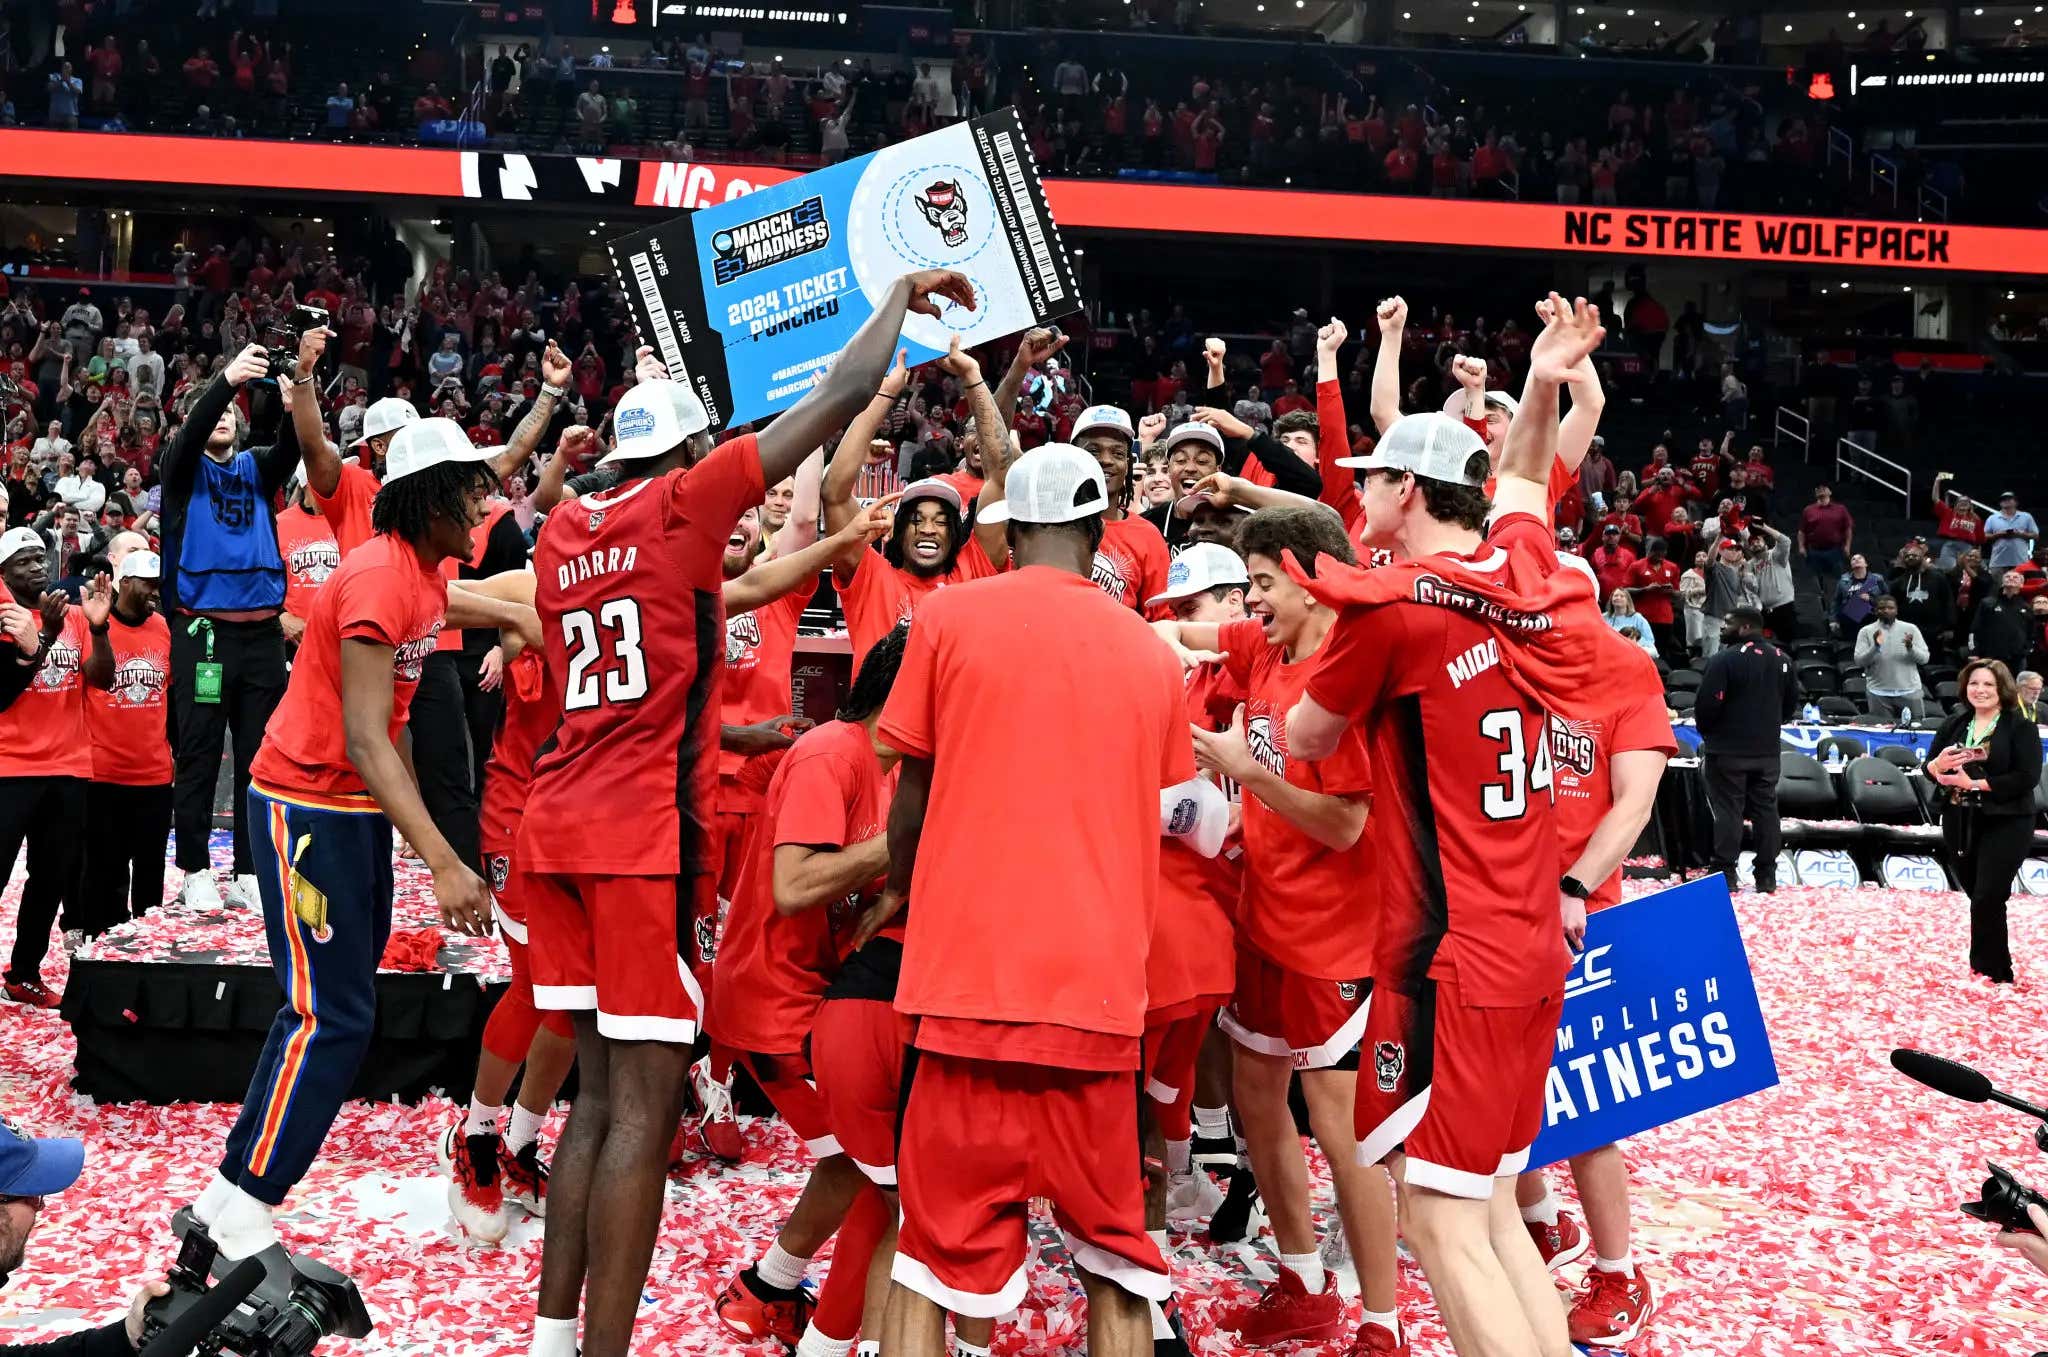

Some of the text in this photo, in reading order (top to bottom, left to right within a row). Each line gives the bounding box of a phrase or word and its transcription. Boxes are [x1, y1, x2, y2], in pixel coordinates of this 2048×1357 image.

[653, 161, 715, 208] NC
[732, 212, 793, 249] MARCH
[745, 221, 827, 265] MADNESS
[976, 127, 1047, 317] NCAA TOURNAMENT AUTOMATIC QUALIFIER
[1565, 211, 1949, 263] NC STATE WOLFPACK
[649, 238, 669, 277] SEAT 24
[727, 266, 848, 326] 2024 TICKET
[750, 294, 839, 342] PUNCHED
[673, 310, 692, 344] ROW 17
[700, 385, 720, 426] SECTION
[290, 551, 339, 574] CHAMPIO
[558, 546, 637, 591] DIARRA
[1091, 566, 1126, 603] PIONS
[561, 596, 648, 711] 23
[797, 665, 823, 675] ACC
[1446, 637, 1500, 689] MIDD
[1479, 708, 1555, 822] 34
[1805, 861, 1851, 873] ACC
[1895, 866, 1938, 879] ACC
[1556, 977, 1719, 1052] MPLISH
[1545, 1011, 1736, 1126] ATNESS
